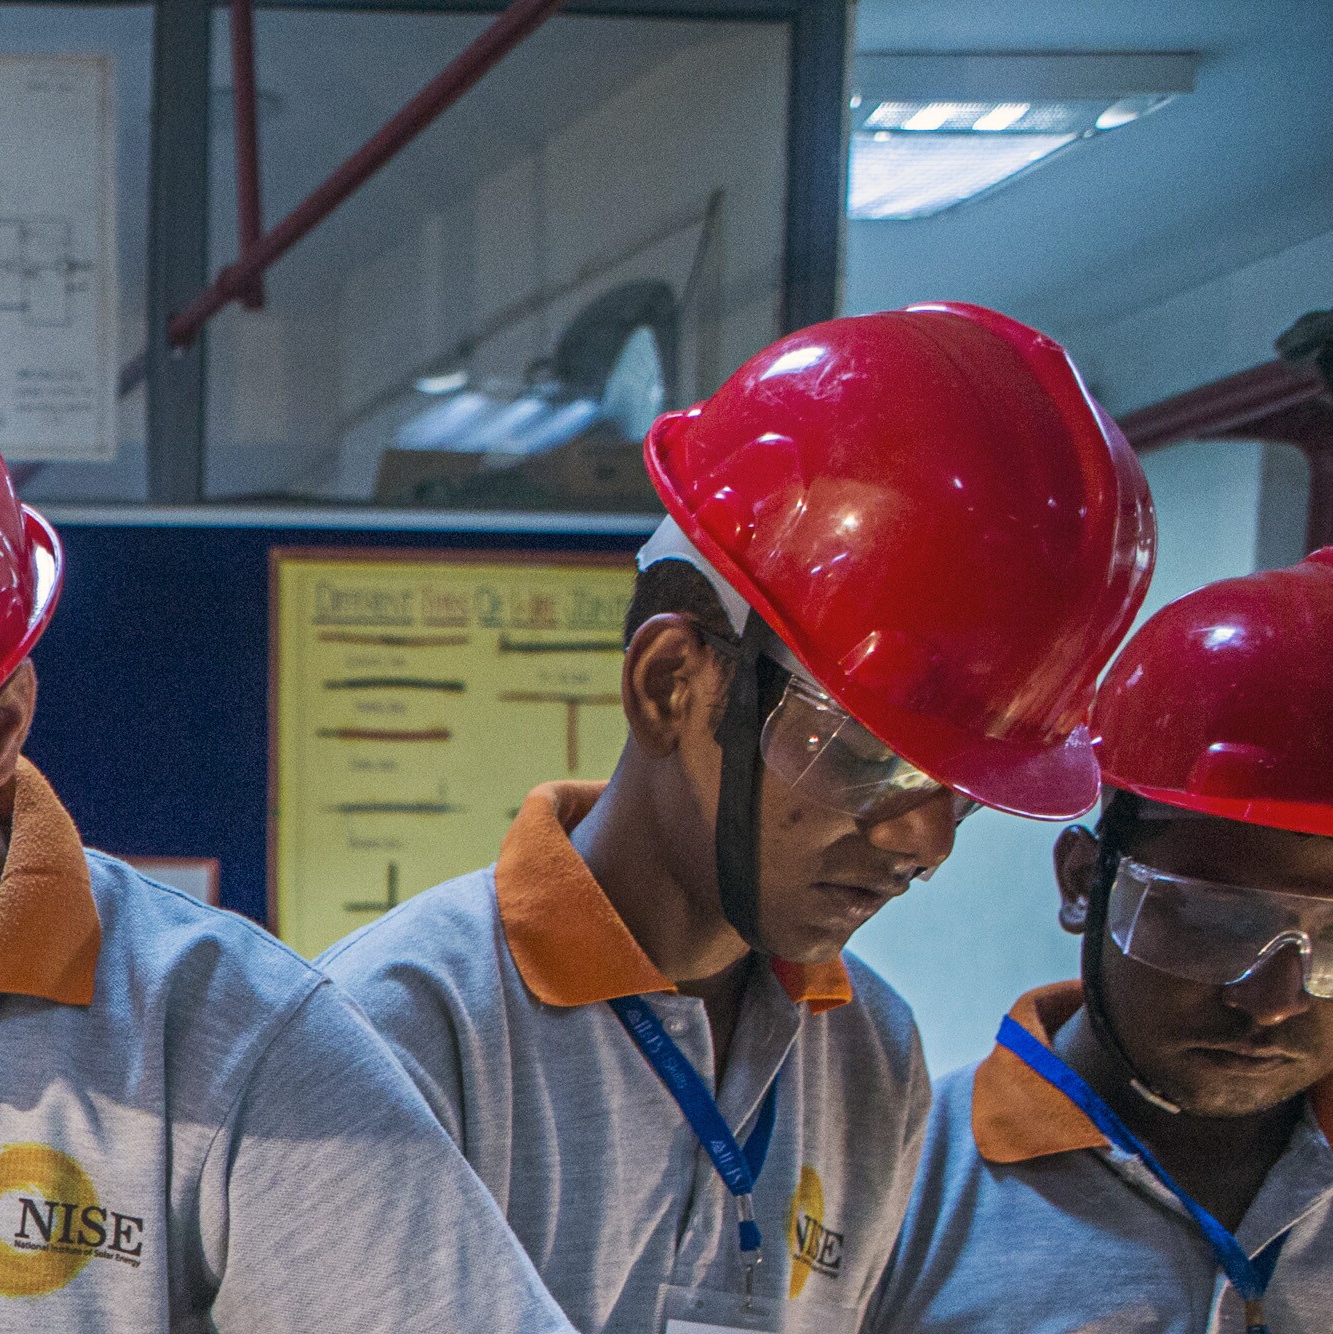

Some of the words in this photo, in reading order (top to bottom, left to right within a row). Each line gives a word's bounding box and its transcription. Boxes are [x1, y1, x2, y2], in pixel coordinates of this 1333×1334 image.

[13, 1197, 144, 1258] NISE
[13, 1238, 50, 1252] National
[51, 1243, 83, 1256] Institute
[84, 1247, 94, 1257] of
[94, 1249, 114, 1261] Solar
[114, 1253, 142, 1269] Energy
